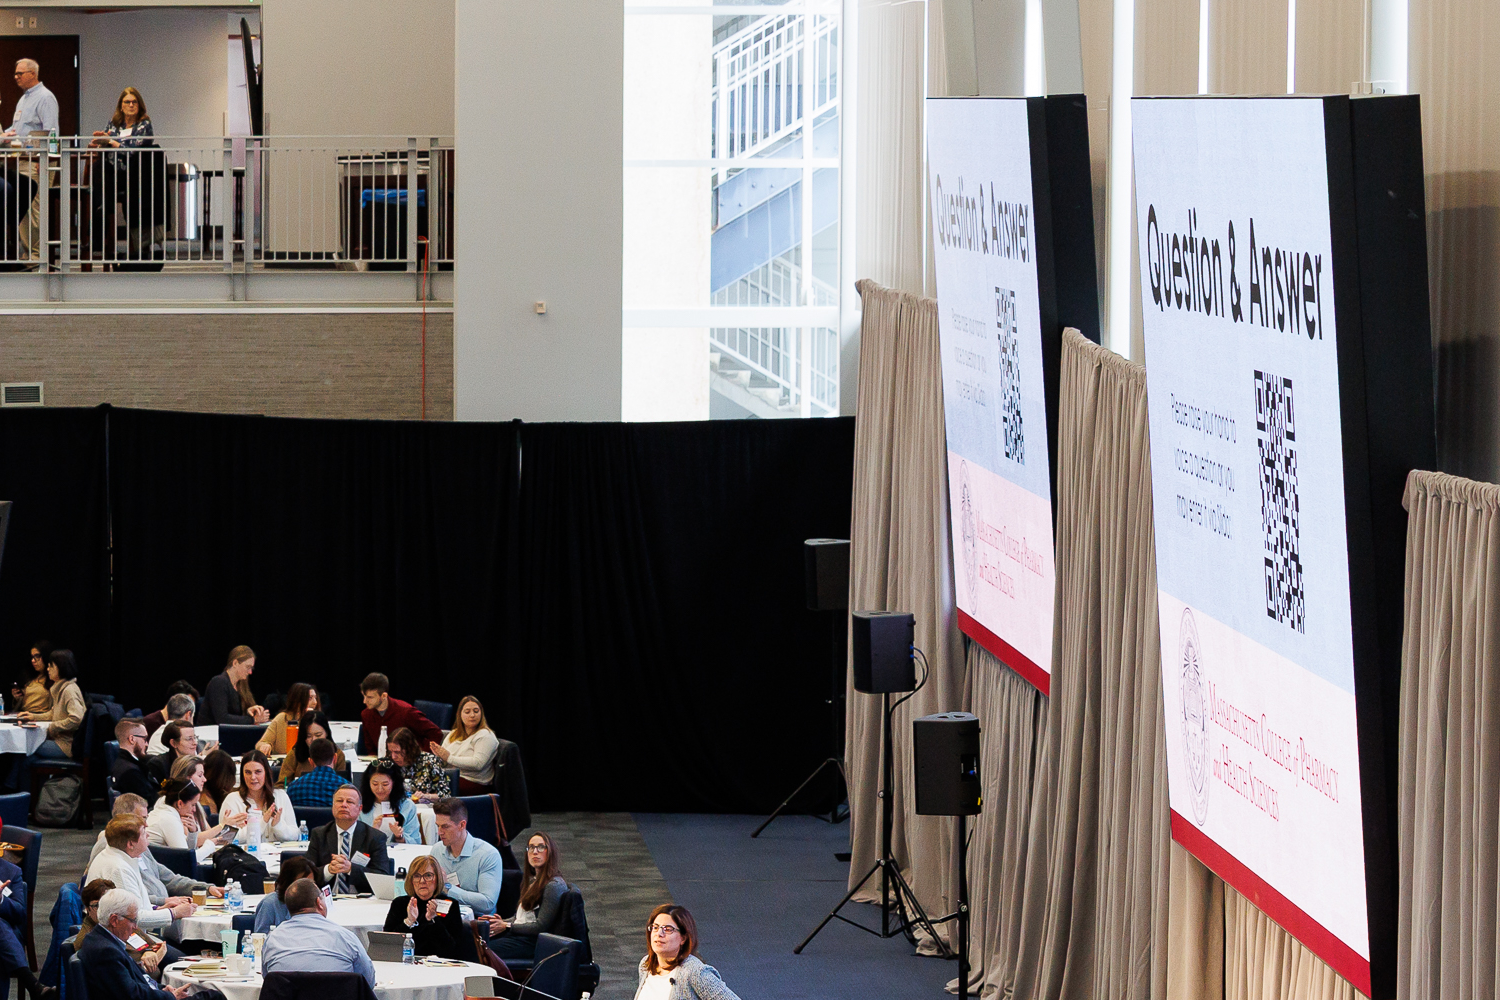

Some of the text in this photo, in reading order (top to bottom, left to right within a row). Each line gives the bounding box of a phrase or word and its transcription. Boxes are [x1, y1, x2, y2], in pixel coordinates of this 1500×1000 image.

[936, 174, 1029, 263] Question & Answer
[1148, 204, 1322, 340] Question & Answer
